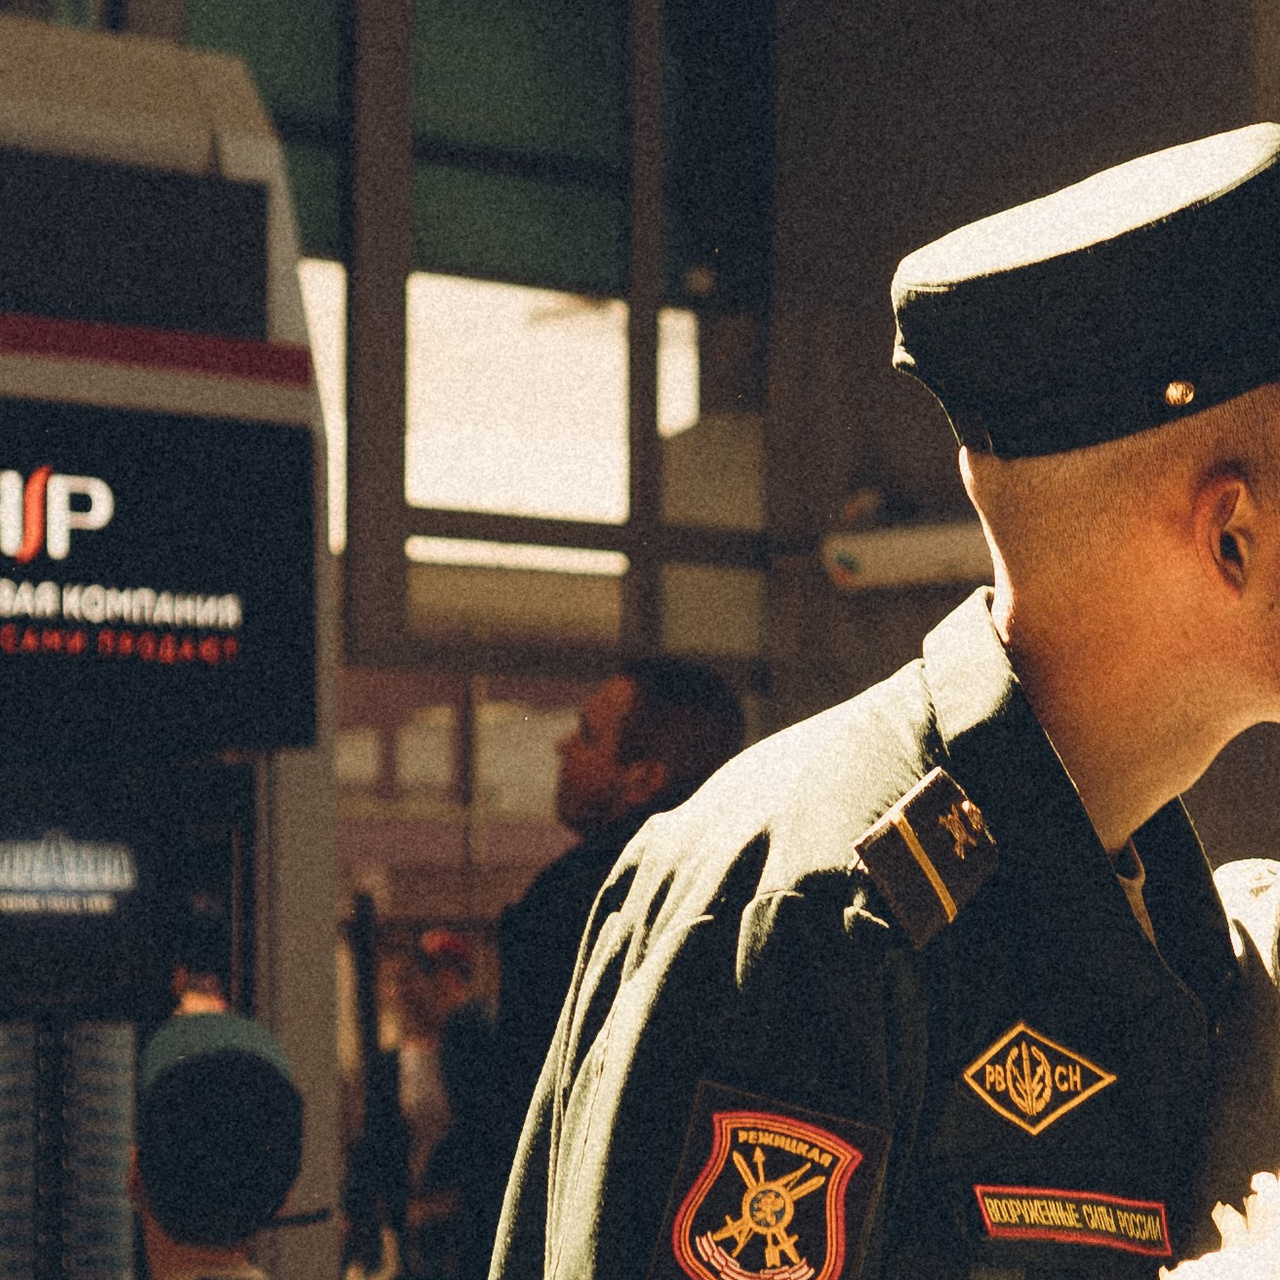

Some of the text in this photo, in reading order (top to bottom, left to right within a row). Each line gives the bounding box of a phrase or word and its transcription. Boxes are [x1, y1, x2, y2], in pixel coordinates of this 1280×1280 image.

[62, 583, 242, 630] КОМПАНИЯ
[985, 1063, 1082, 1092] РВ СН
[737, 1129, 834, 1168] РЕЖИЦКАЯ
[984, 1197, 1162, 1242] ВООРУЖЕННЫЕ СИЛЫ РОССИИ
